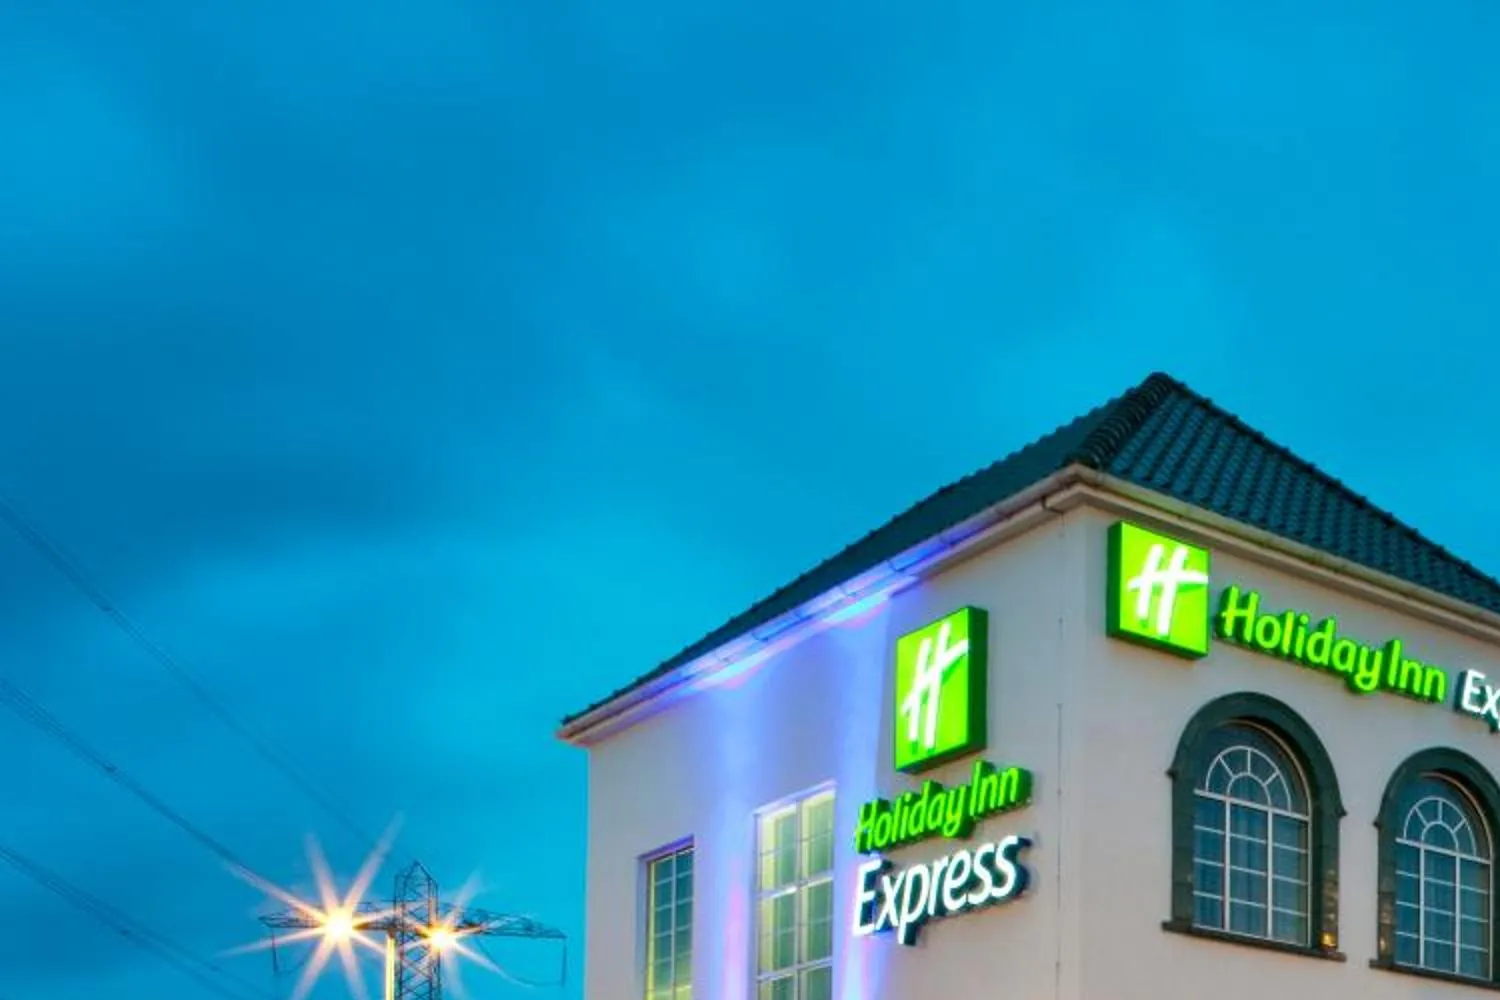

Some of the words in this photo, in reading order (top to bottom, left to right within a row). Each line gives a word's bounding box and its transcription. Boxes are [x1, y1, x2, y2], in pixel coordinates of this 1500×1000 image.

[1219, 584, 1383, 691] Holiday
[1385, 638, 1447, 703] Inn
[855, 779, 968, 853] Holiday
[968, 759, 1026, 818] Inn
[852, 834, 1021, 945] Express
